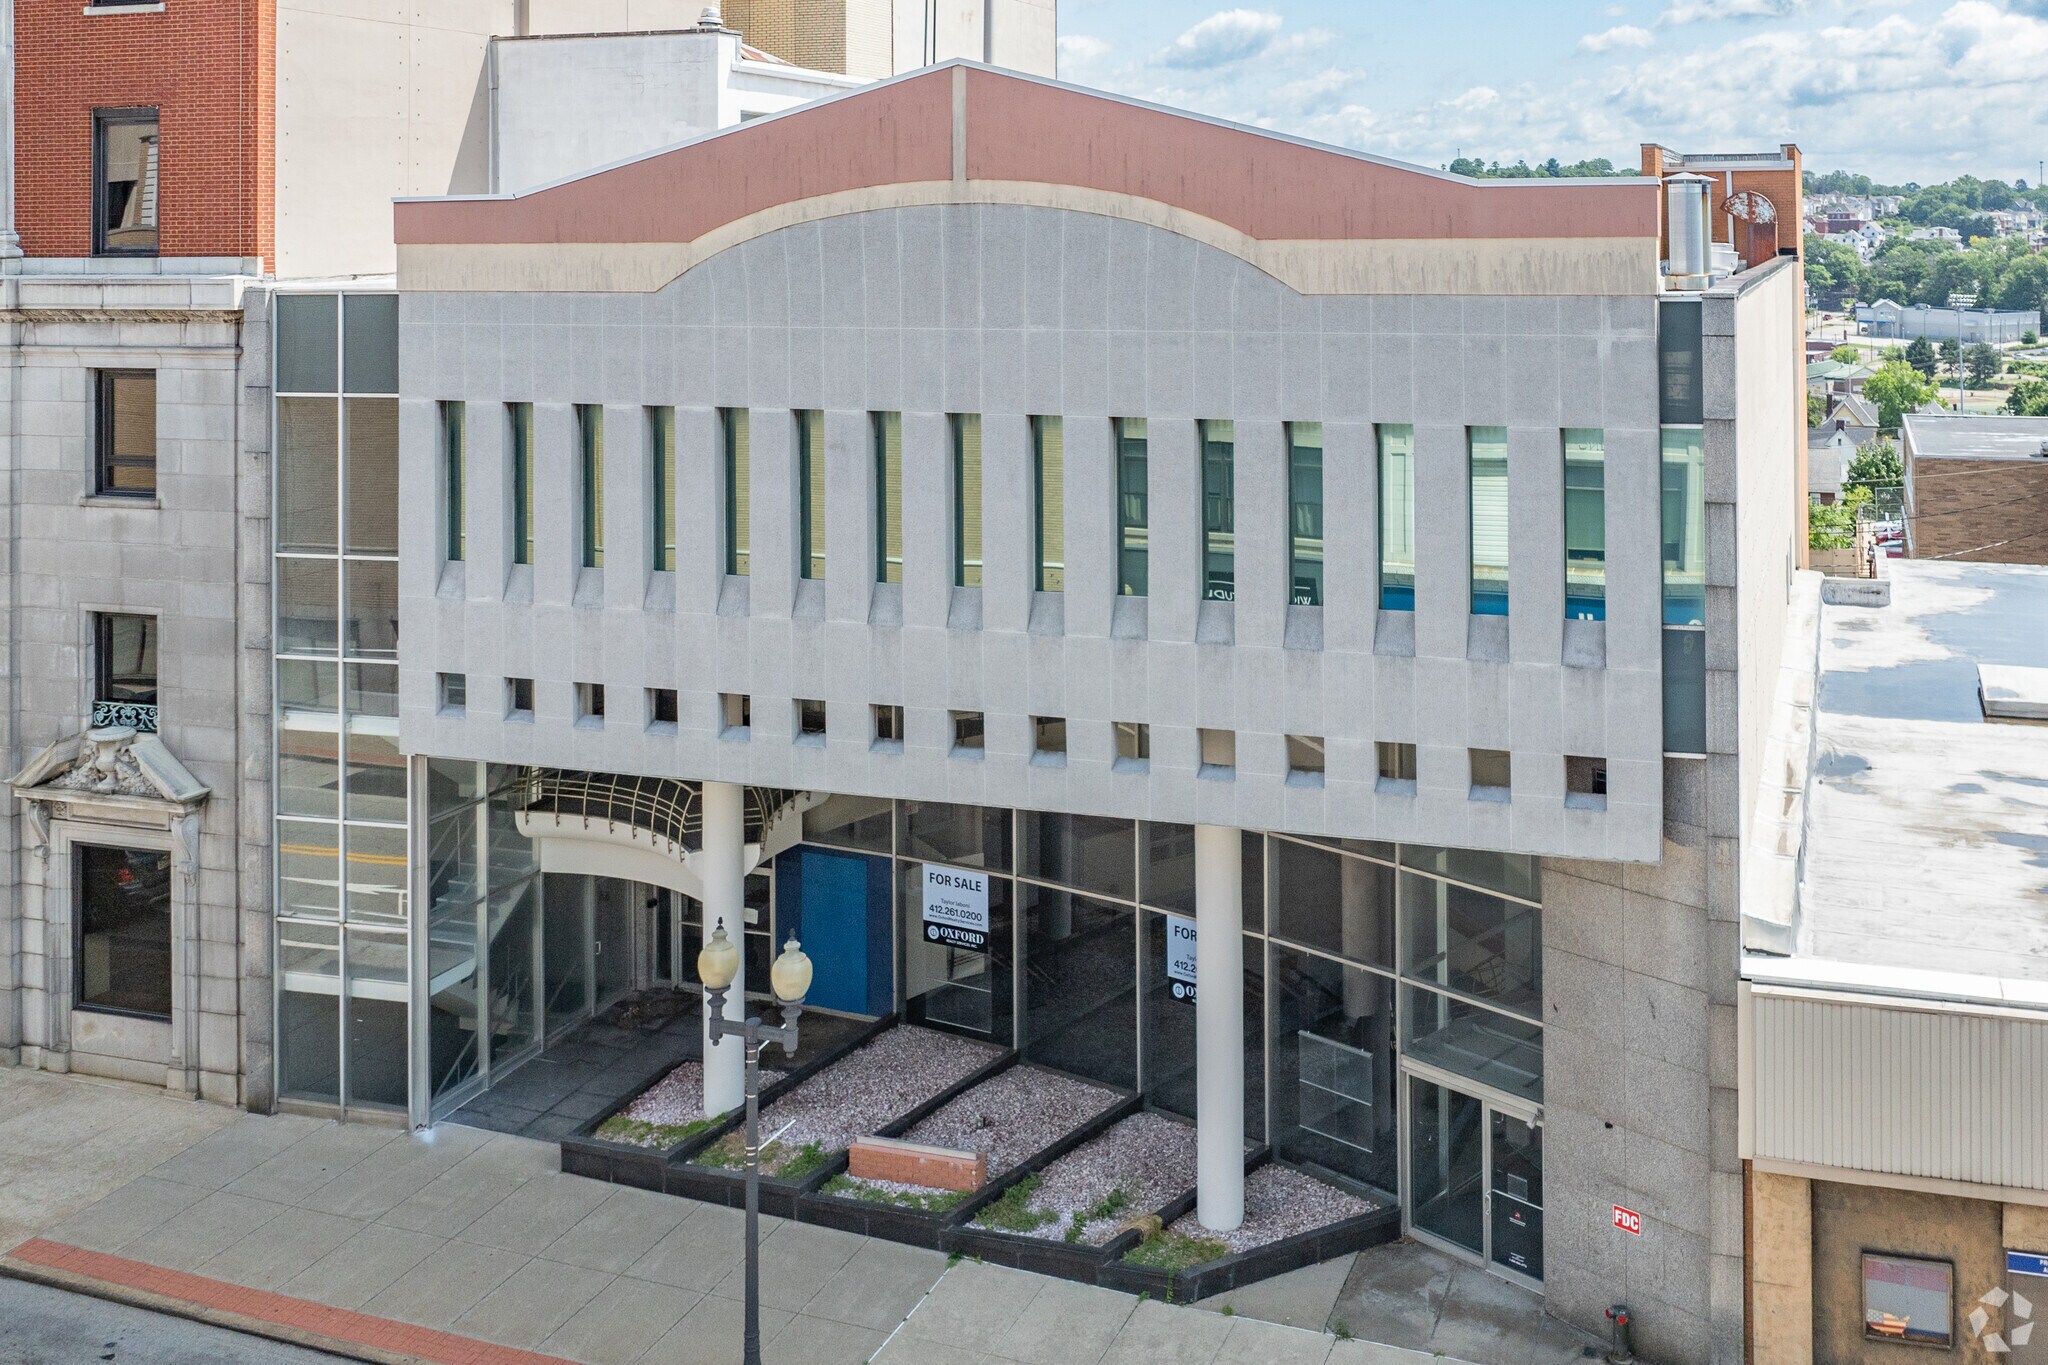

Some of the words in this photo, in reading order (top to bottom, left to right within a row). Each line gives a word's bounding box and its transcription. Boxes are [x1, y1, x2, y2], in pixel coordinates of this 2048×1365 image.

[929, 872, 952, 887] FOR
[954, 876, 982, 892] SALE
[941, 898, 955, 906] Taylor
[929, 904, 983, 922] 412.261.0200
[940, 926, 984, 945] OXFORD
[1174, 925, 1197, 942] FOR
[1614, 1209, 1639, 1231] FDC
